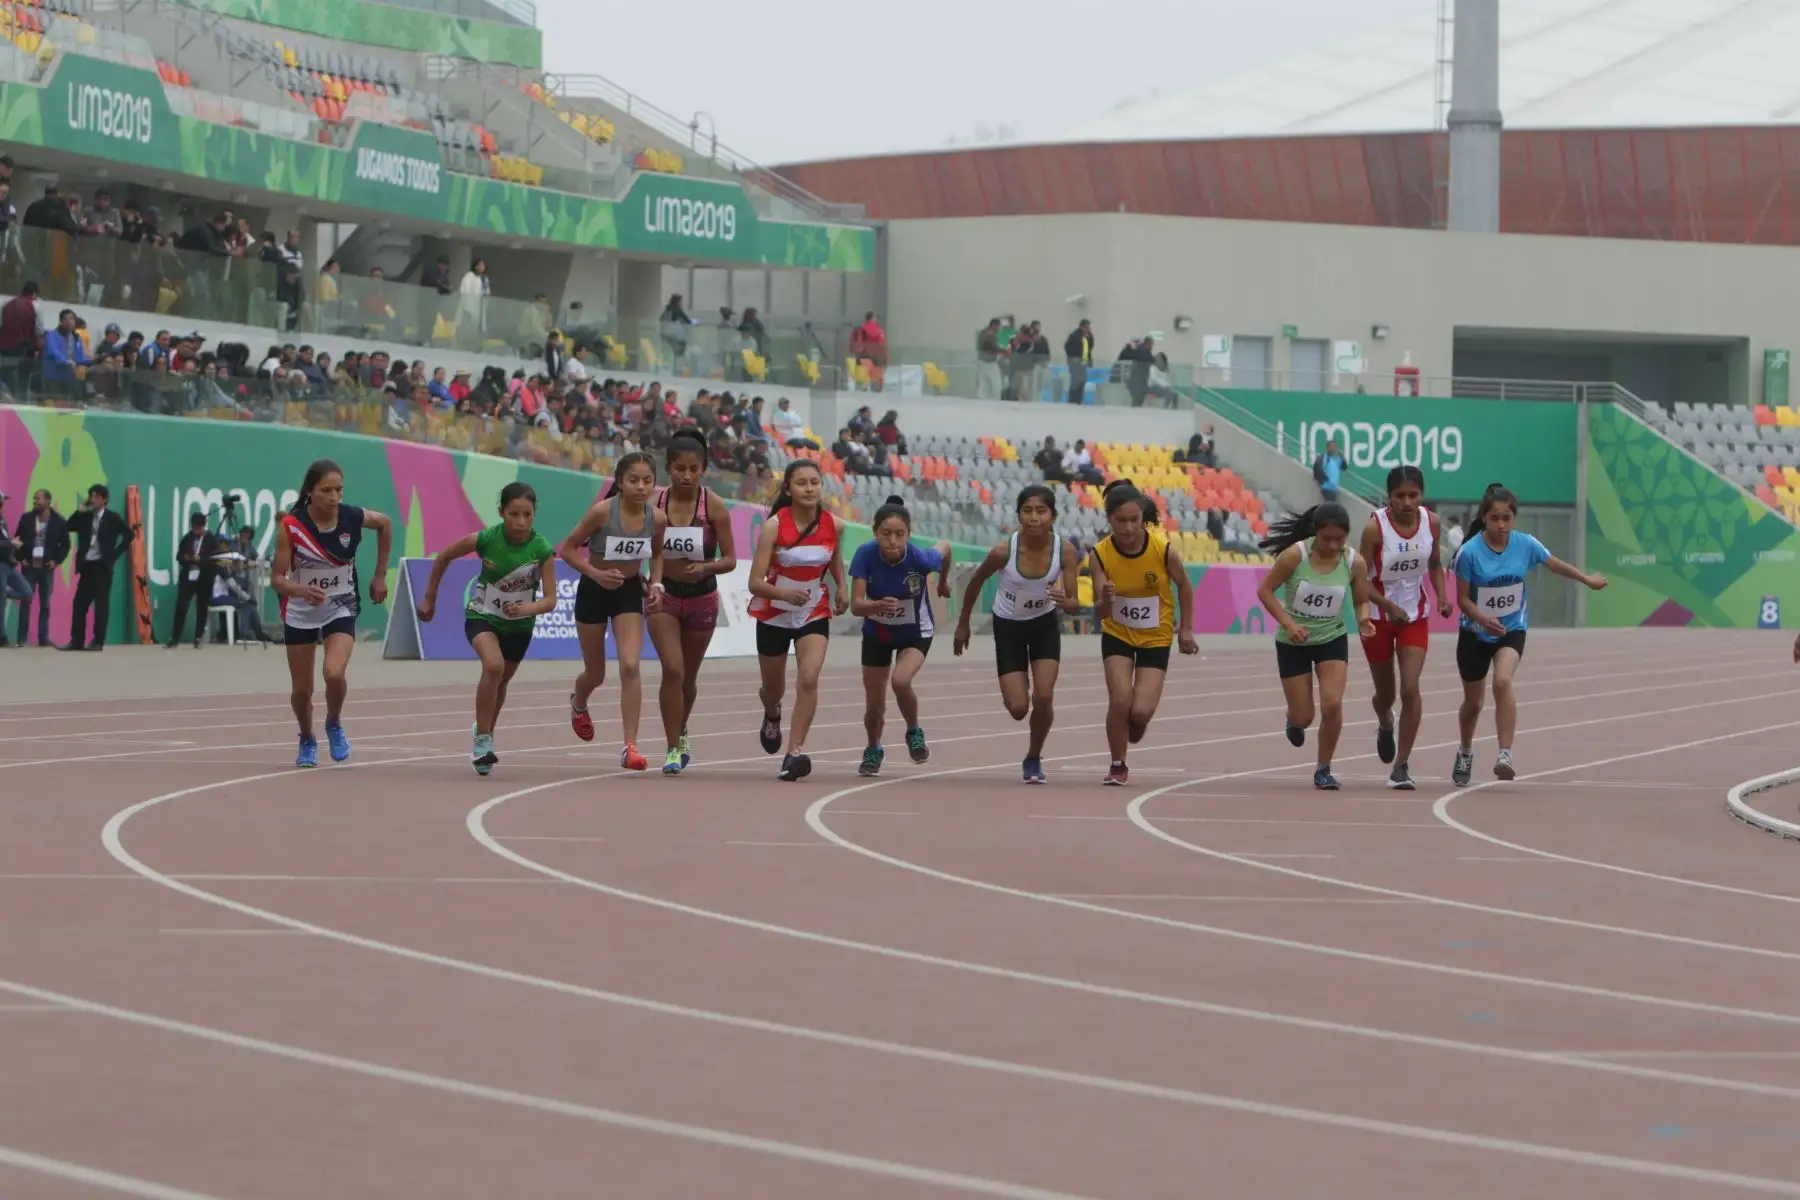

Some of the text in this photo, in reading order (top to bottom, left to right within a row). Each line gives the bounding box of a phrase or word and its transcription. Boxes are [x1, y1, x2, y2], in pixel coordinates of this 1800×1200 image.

[356, 147, 440, 194] JUGAMOS TODOS
[614, 540, 645, 555] 467
[663, 538, 695, 553] 466
[1389, 558, 1420, 572] 463
[307, 575, 341, 590] 464
[1023, 599, 1049, 609] 46
[1302, 593, 1334, 608] 461
[1484, 594, 1516, 609] 469
[1119, 605, 1151, 620] 462
[1761, 600, 1779, 624] 8
[531, 626, 580, 639] NACION
